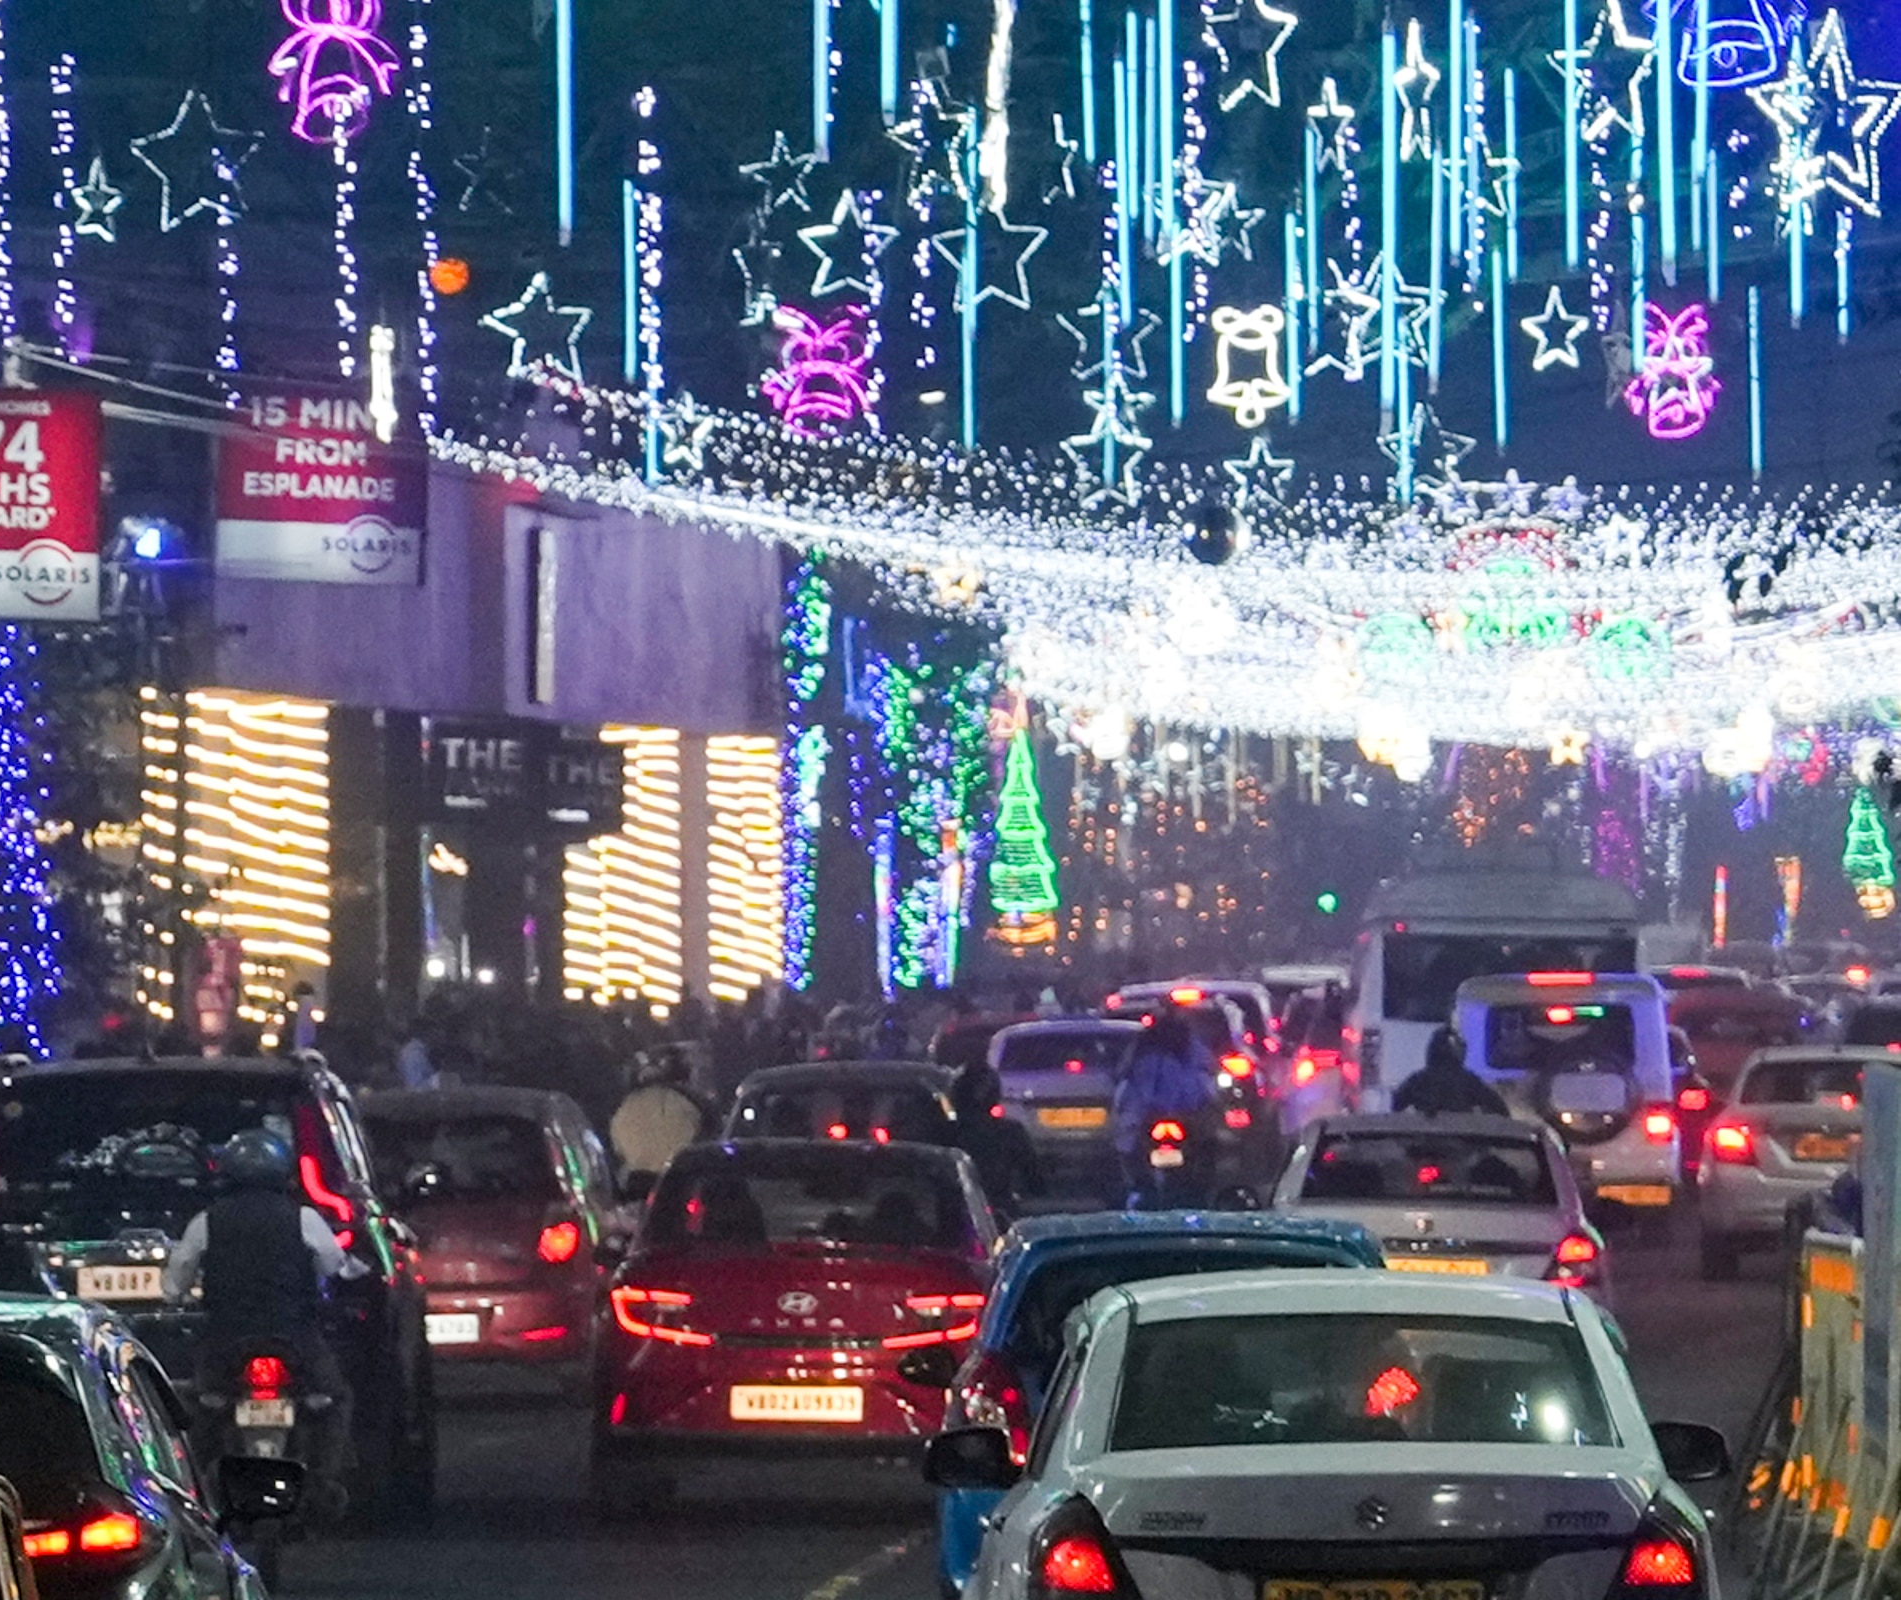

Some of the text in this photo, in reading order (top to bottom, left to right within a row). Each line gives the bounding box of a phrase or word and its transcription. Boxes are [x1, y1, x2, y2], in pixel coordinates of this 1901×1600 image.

[251, 396, 288, 428] 15
[275, 436, 368, 467] FROM
[242, 471, 397, 502] ESPLANADE
